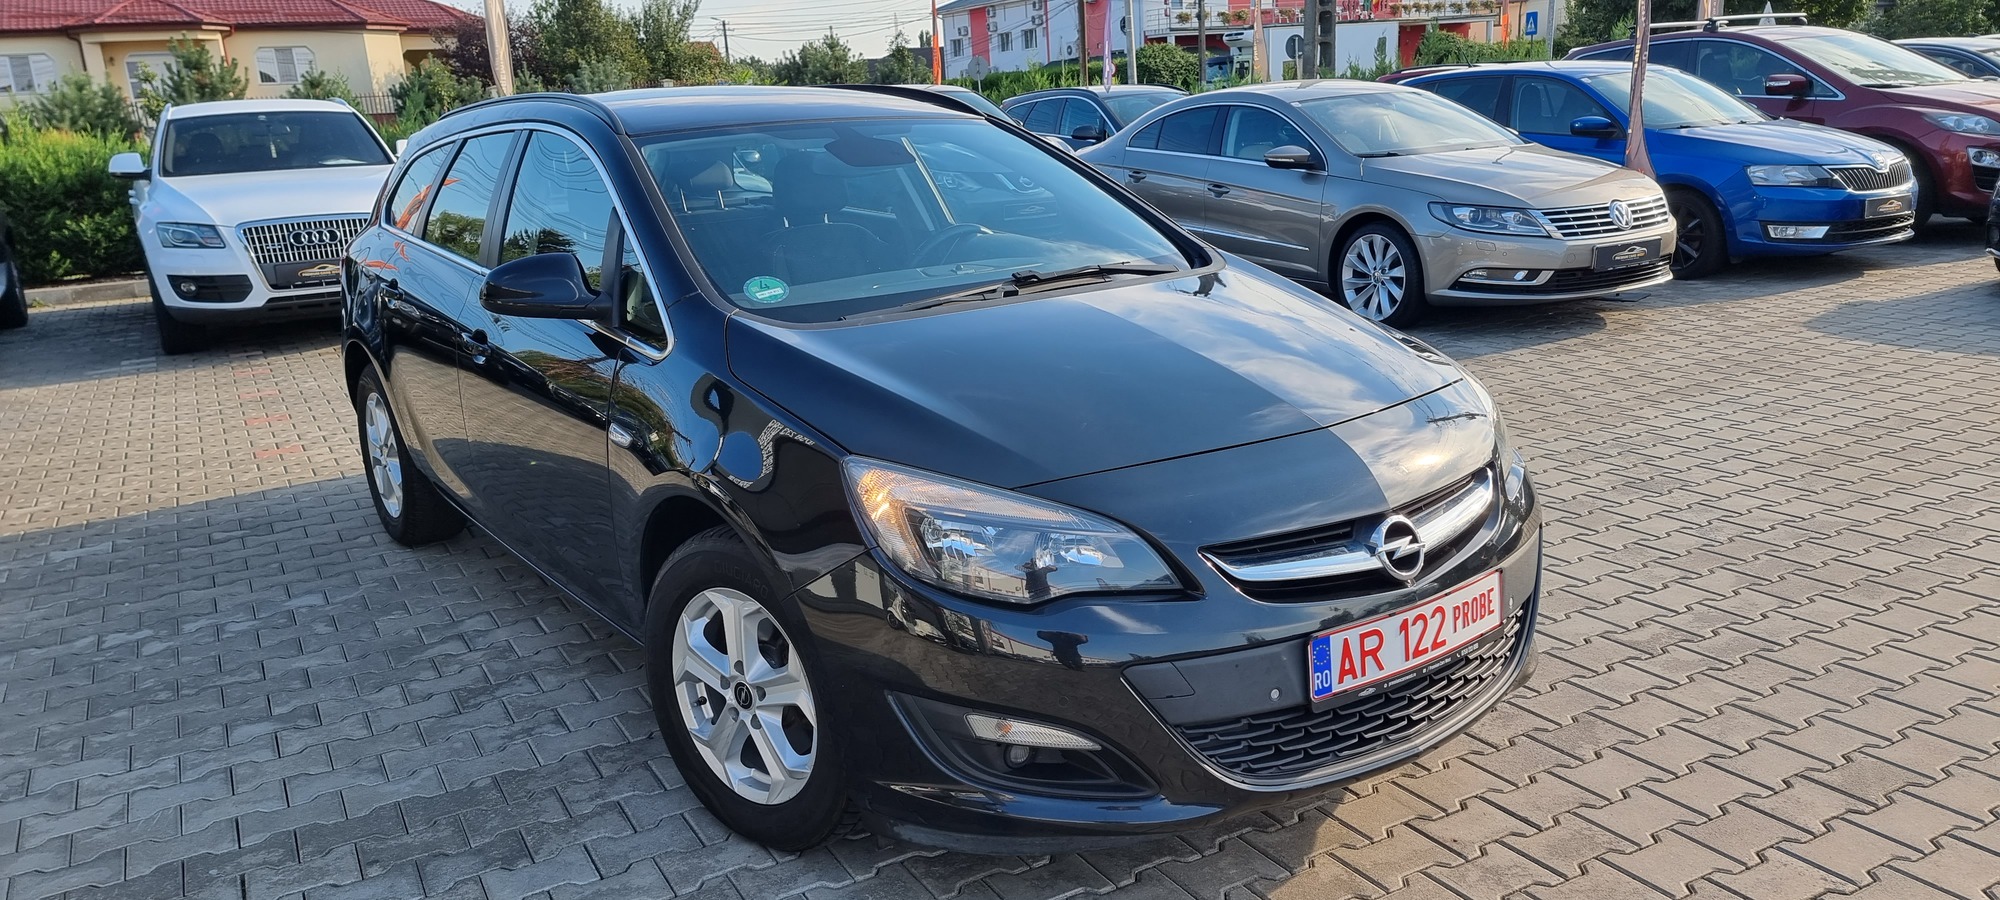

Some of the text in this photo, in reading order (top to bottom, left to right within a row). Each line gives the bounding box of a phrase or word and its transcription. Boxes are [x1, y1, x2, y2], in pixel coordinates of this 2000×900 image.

[1337, 587, 1495, 685] AR 122 PROBE
[1314, 669, 1331, 691] RO
